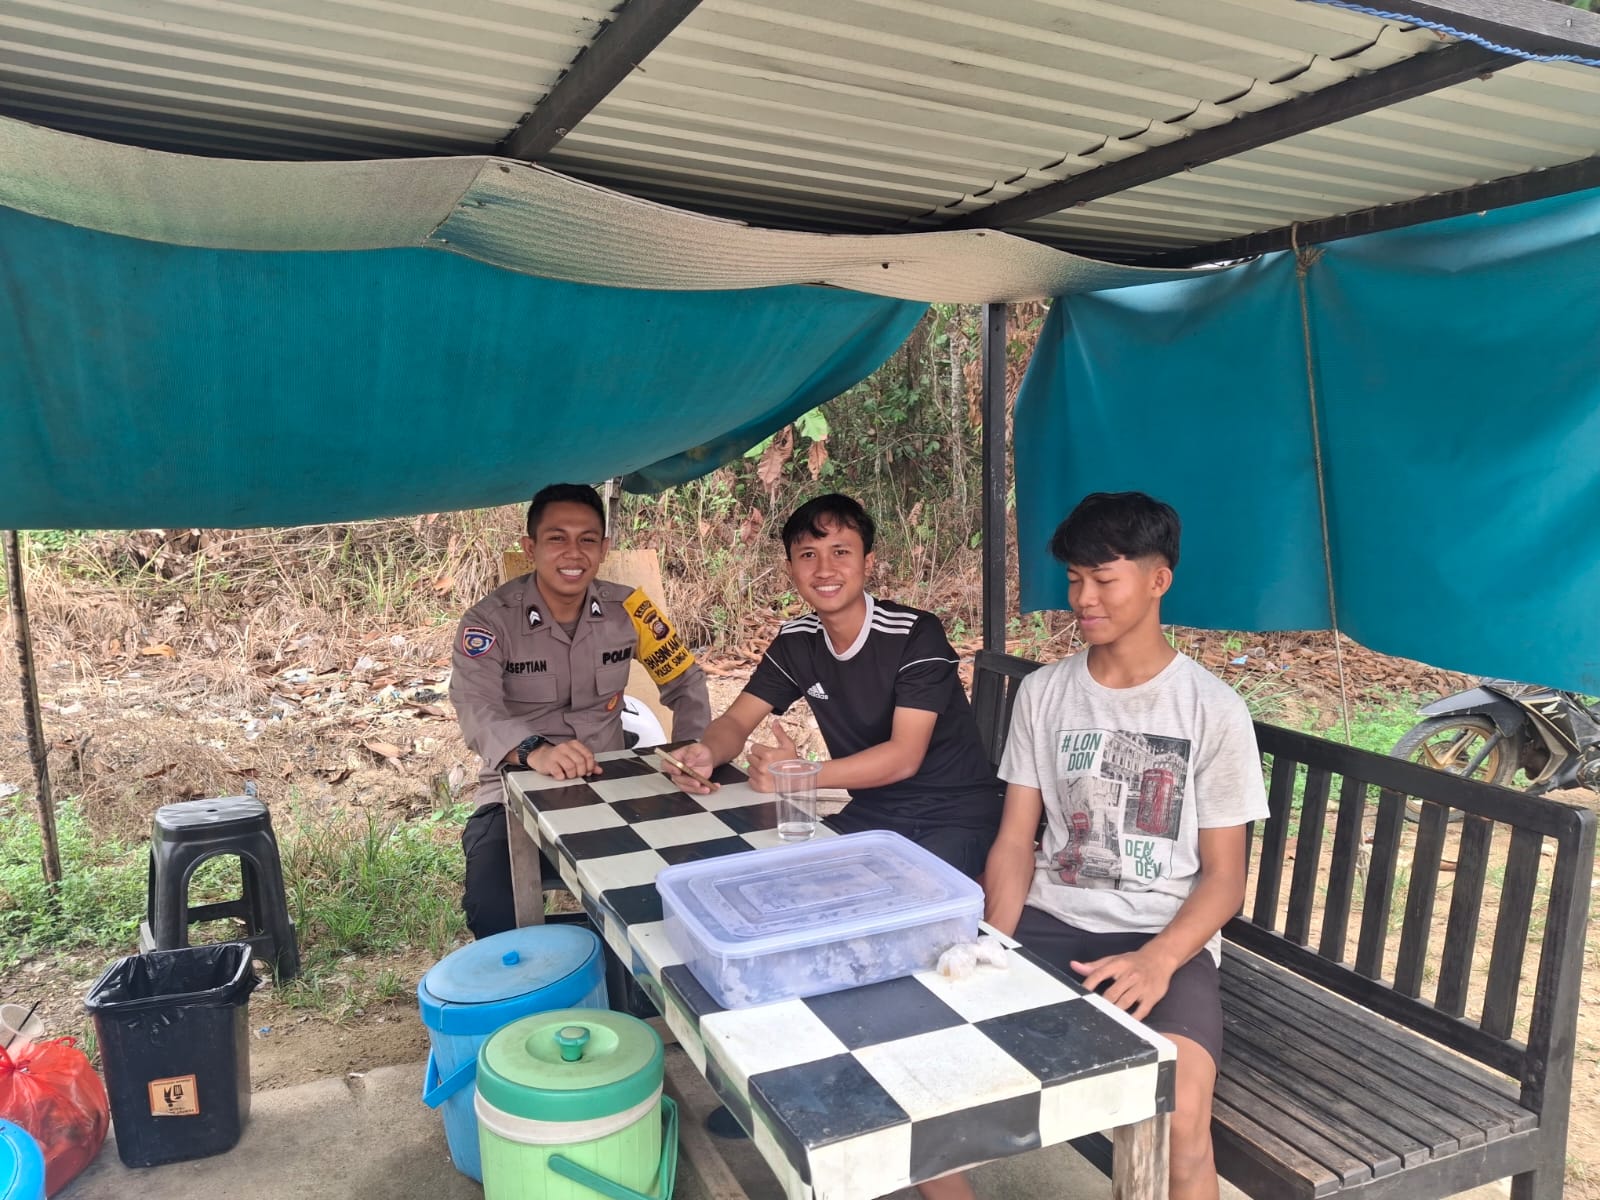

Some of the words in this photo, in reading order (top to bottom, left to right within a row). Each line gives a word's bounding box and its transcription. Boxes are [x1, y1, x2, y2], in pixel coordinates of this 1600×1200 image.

[1067, 752, 1095, 771] DON
[1125, 839, 1155, 857] DEN
[1135, 861, 1162, 879] DEV
